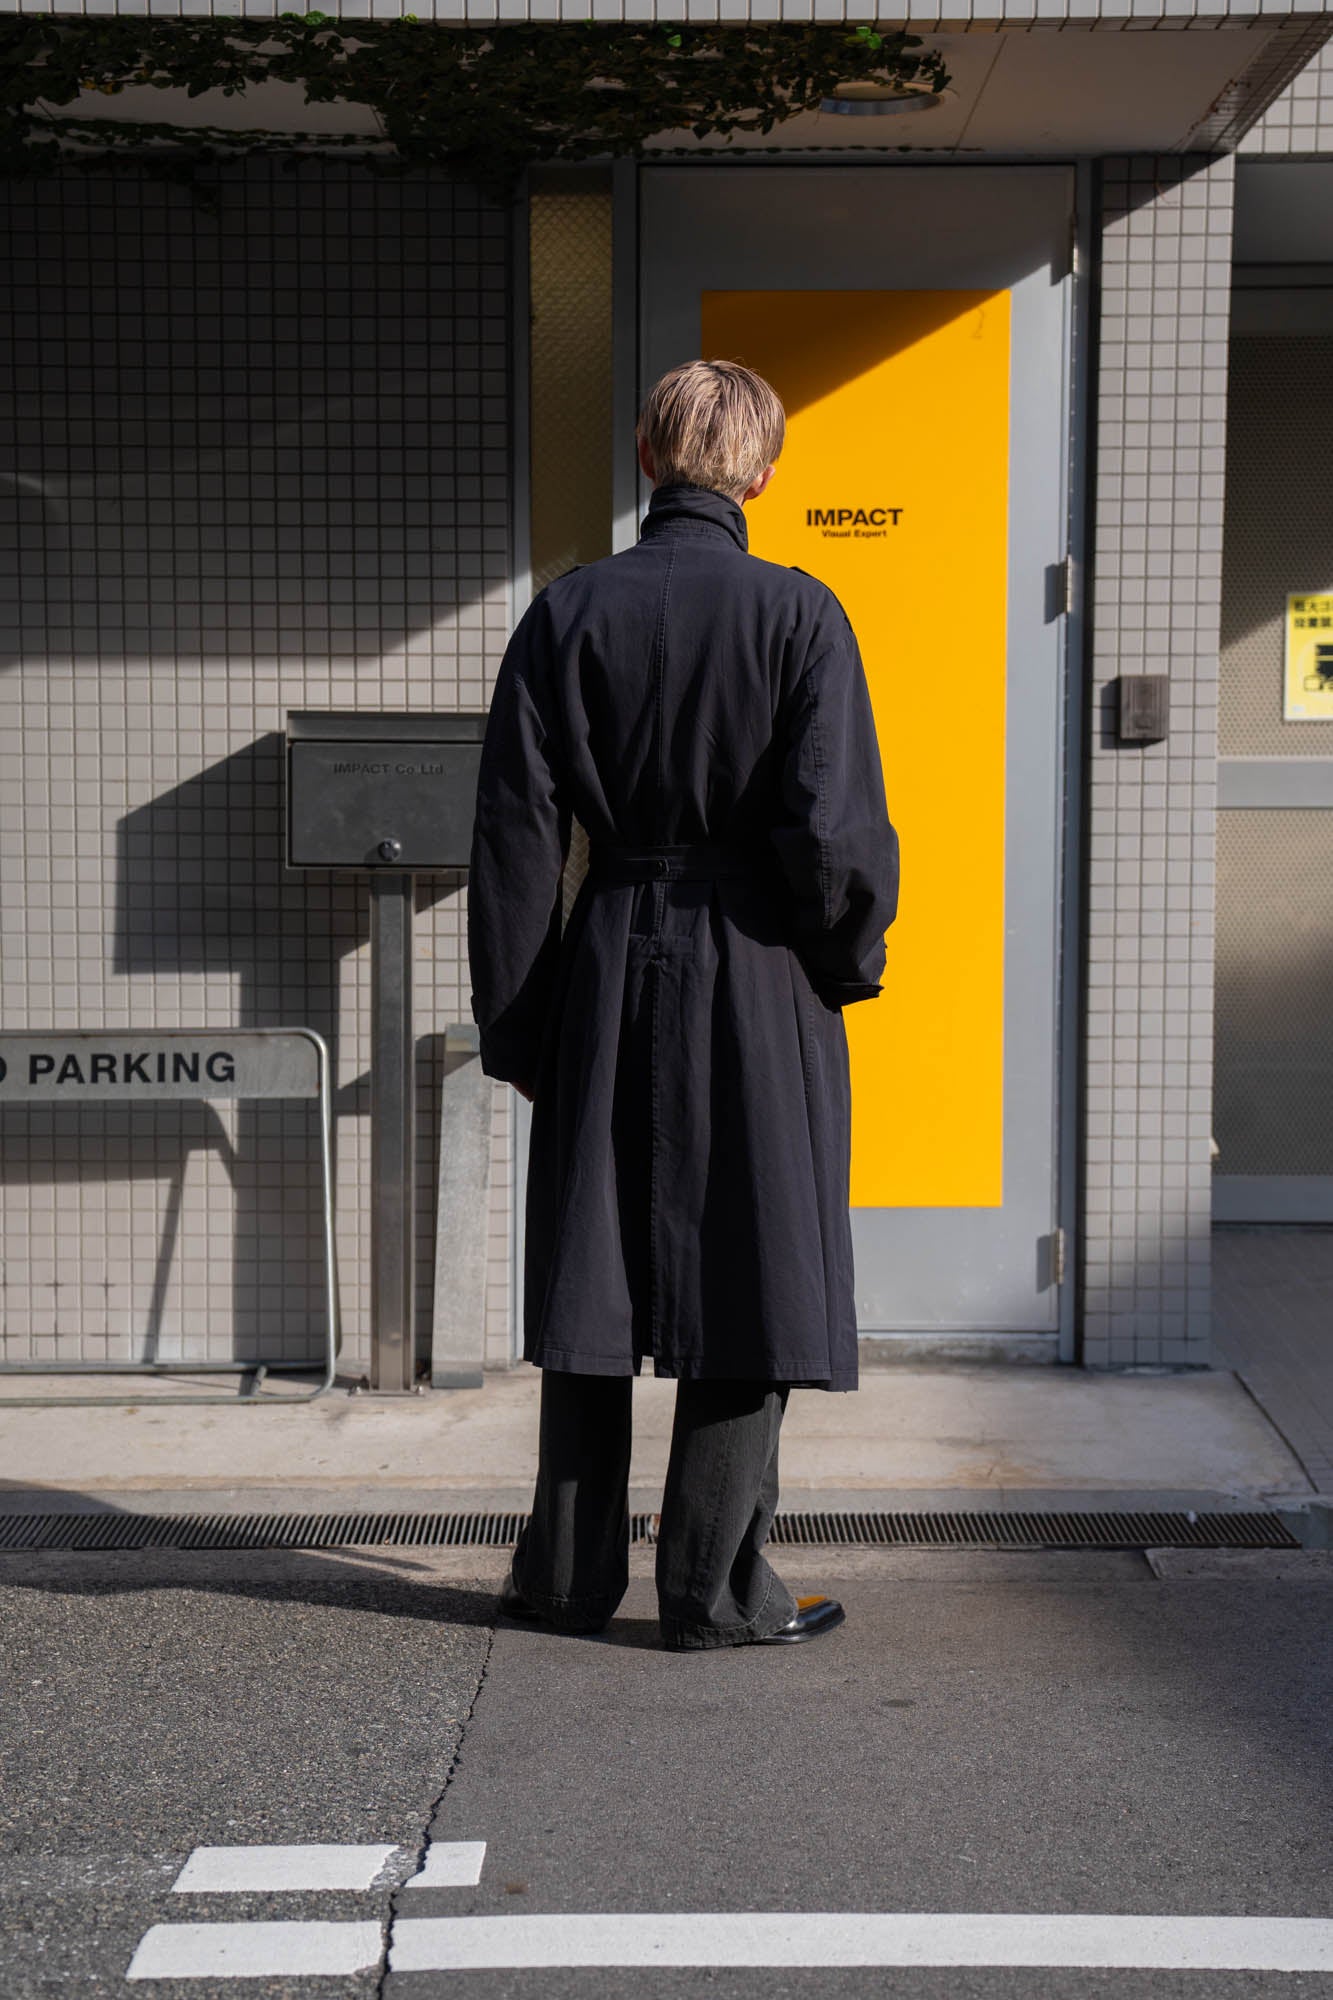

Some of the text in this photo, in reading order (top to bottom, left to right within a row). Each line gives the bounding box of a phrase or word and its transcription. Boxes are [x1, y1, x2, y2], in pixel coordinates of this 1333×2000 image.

[807, 509, 904, 526] IMPACT
[822, 530, 887, 539] Visual Expert
[333, 763, 390, 774] IMPACT
[28, 1052, 235, 1084] PARKING
